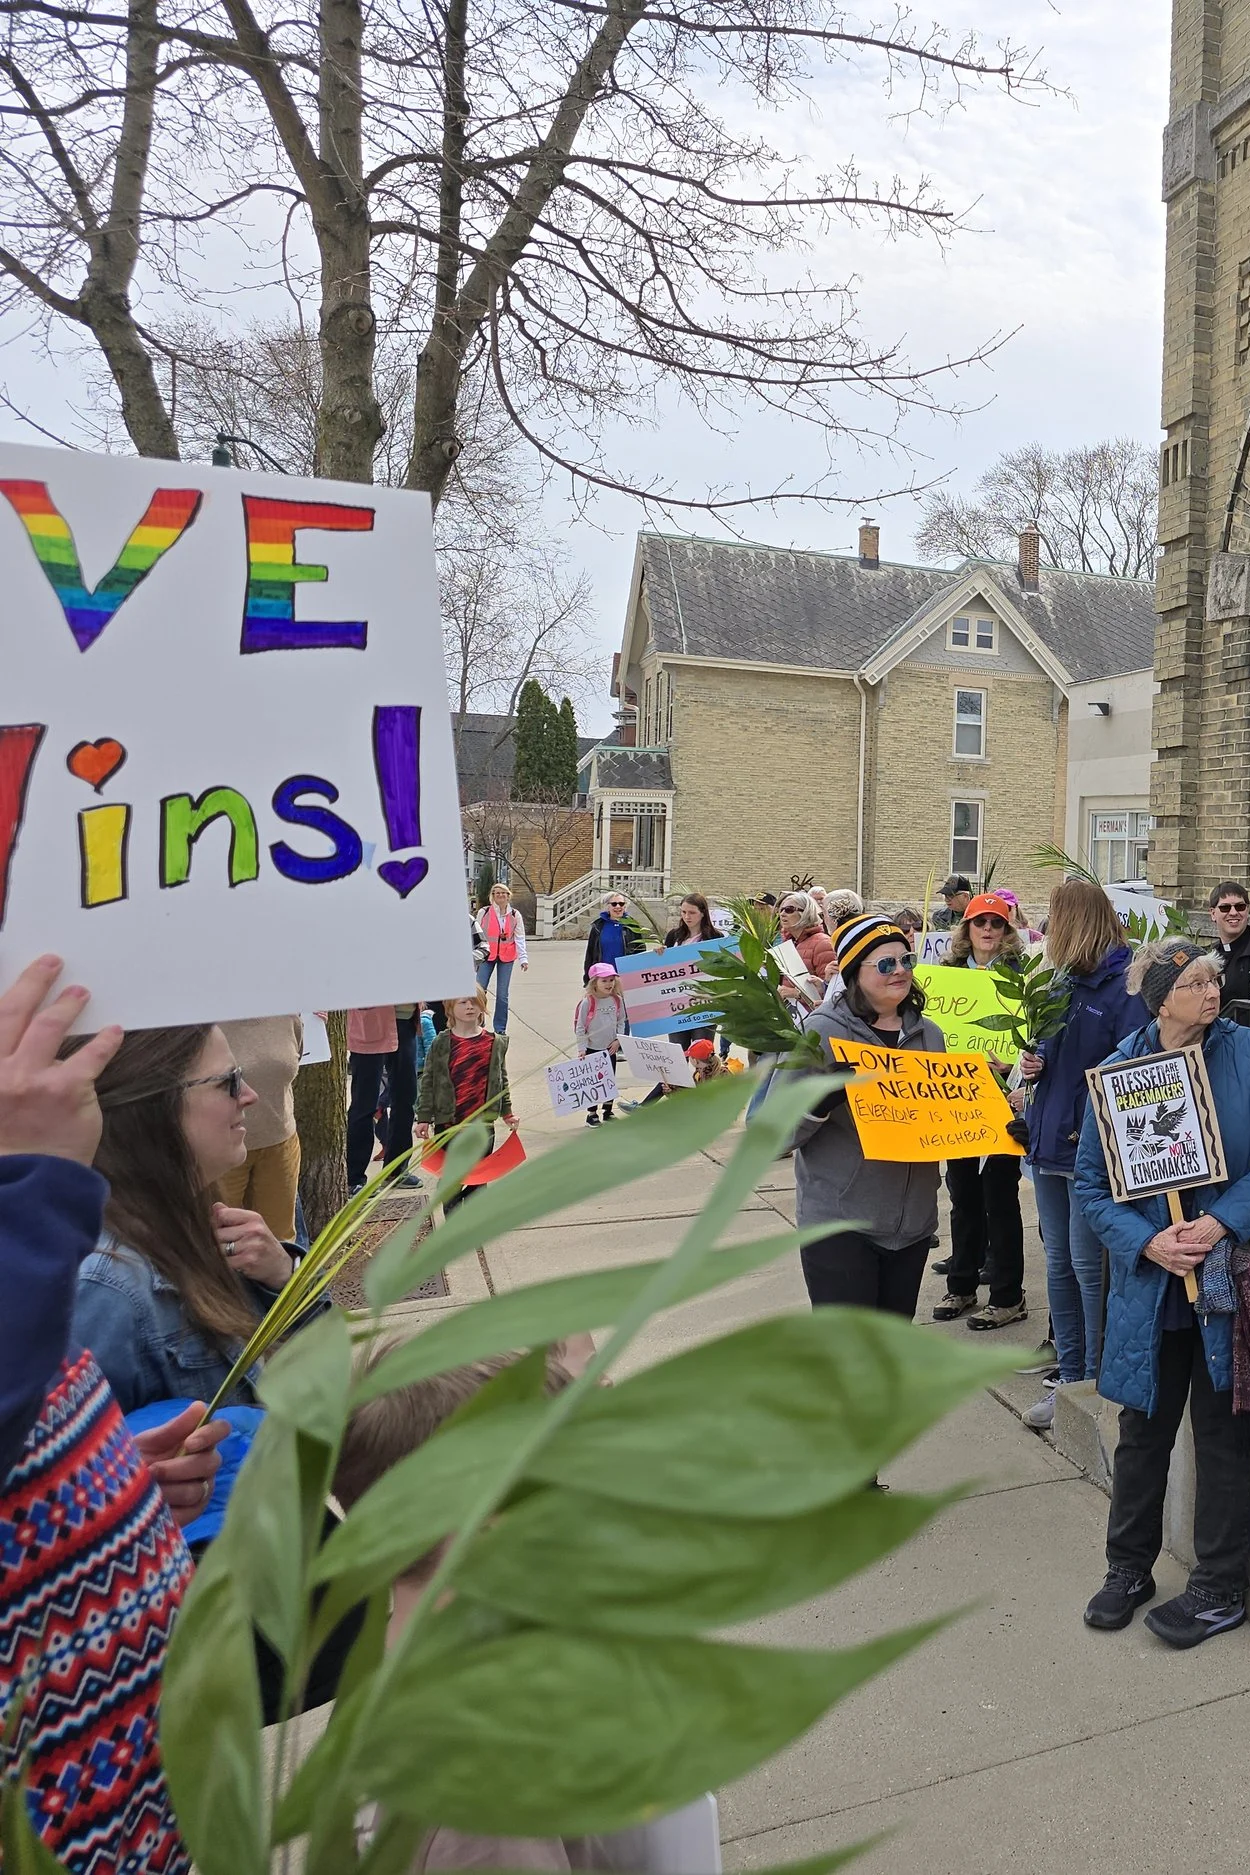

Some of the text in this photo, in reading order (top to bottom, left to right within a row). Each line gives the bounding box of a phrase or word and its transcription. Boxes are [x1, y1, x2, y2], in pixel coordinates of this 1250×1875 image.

[641, 968, 686, 984] Trans
[660, 986, 676, 995] are
[670, 1002, 685, 1012] to
[677, 1017, 692, 1025] and
[693, 1014, 702, 1022] to
[634, 1040, 663, 1053] LOVE
[638, 1052, 674, 1065] TRUMPS
[838, 1046, 986, 1080] LOVE YOUR
[568, 1062, 592, 1079] HATE
[645, 1064, 671, 1074] HATE
[570, 1076, 602, 1091] TRUMPS
[1110, 1062, 1178, 1096] BLESSED ARE
[1166, 1072, 1181, 1083] THE
[569, 1085, 608, 1109] LOVE
[1115, 1081, 1185, 1112] PEACEMAKERS
[929, 1111, 943, 1122] IS
[951, 1108, 987, 1124] YOUR
[1169, 1140, 1196, 1157] NOT THE
[1130, 1153, 1201, 1185] KINGMAKERS
